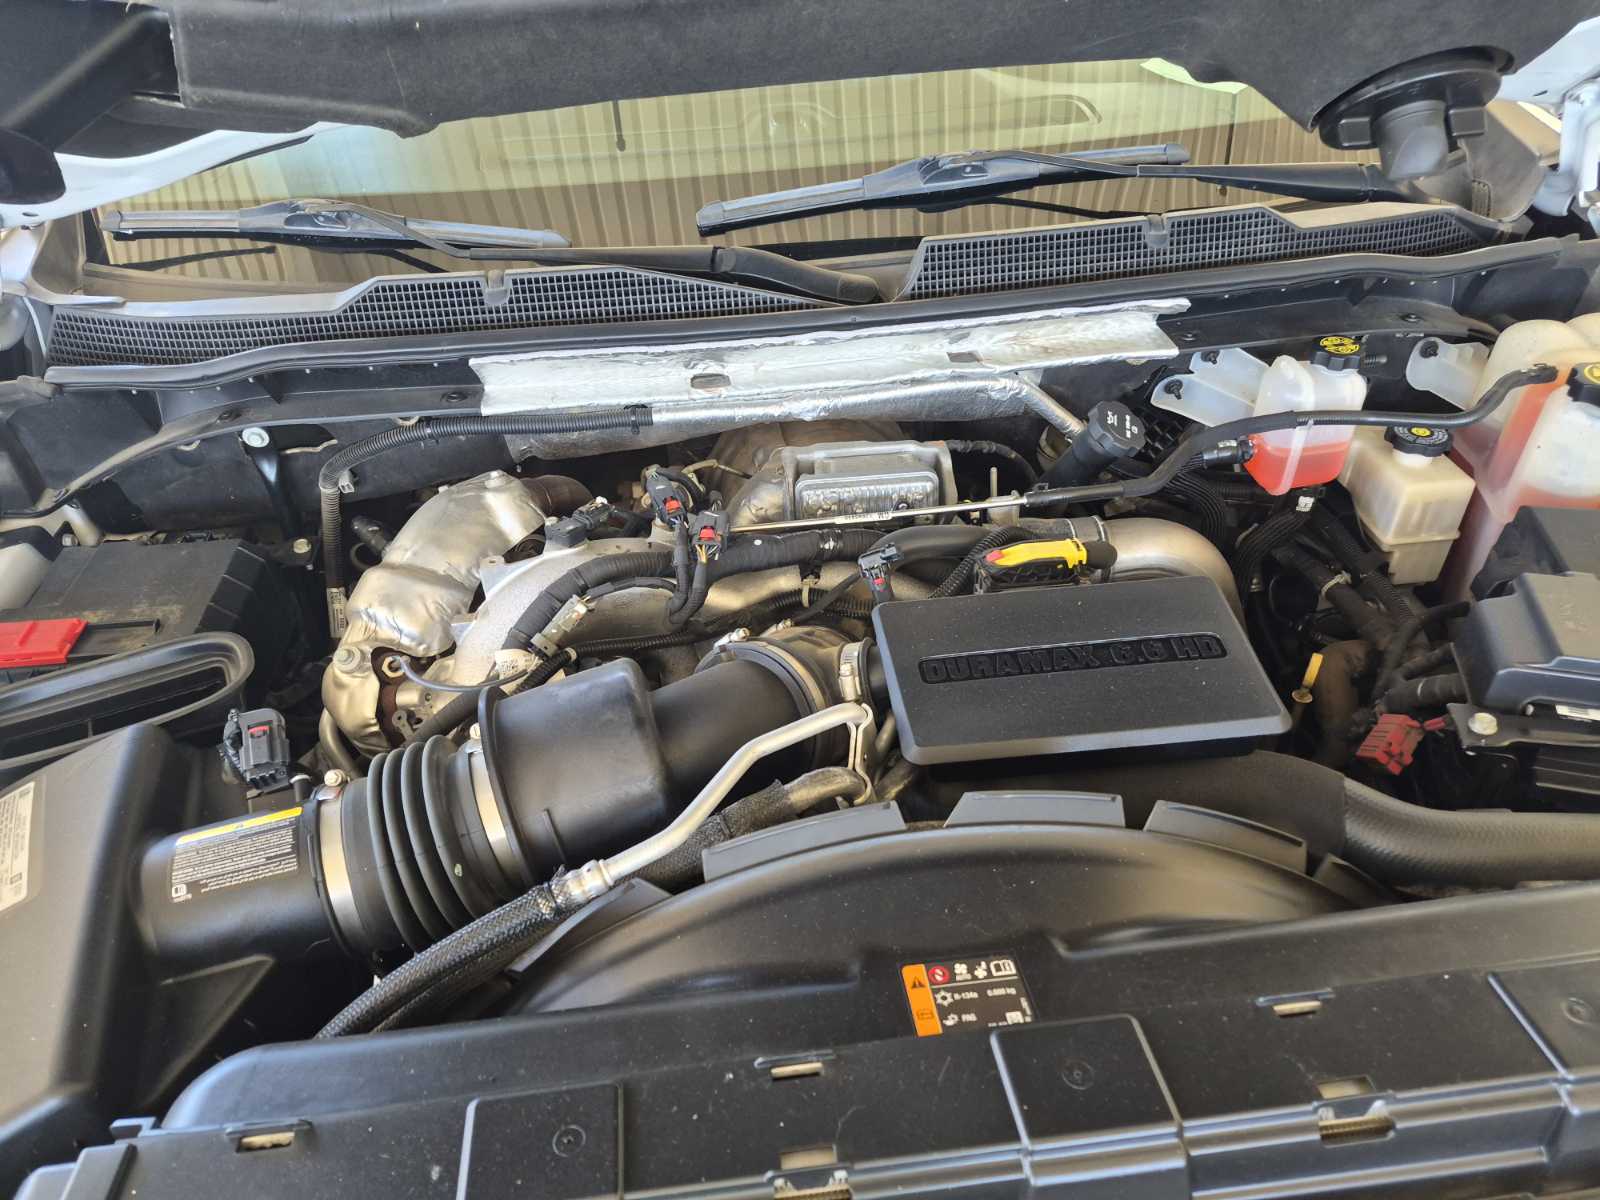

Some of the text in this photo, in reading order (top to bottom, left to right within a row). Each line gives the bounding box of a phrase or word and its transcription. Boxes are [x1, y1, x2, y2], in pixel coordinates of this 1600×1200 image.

[925, 635, 1221, 681] DURAMAX 6.6 HD
